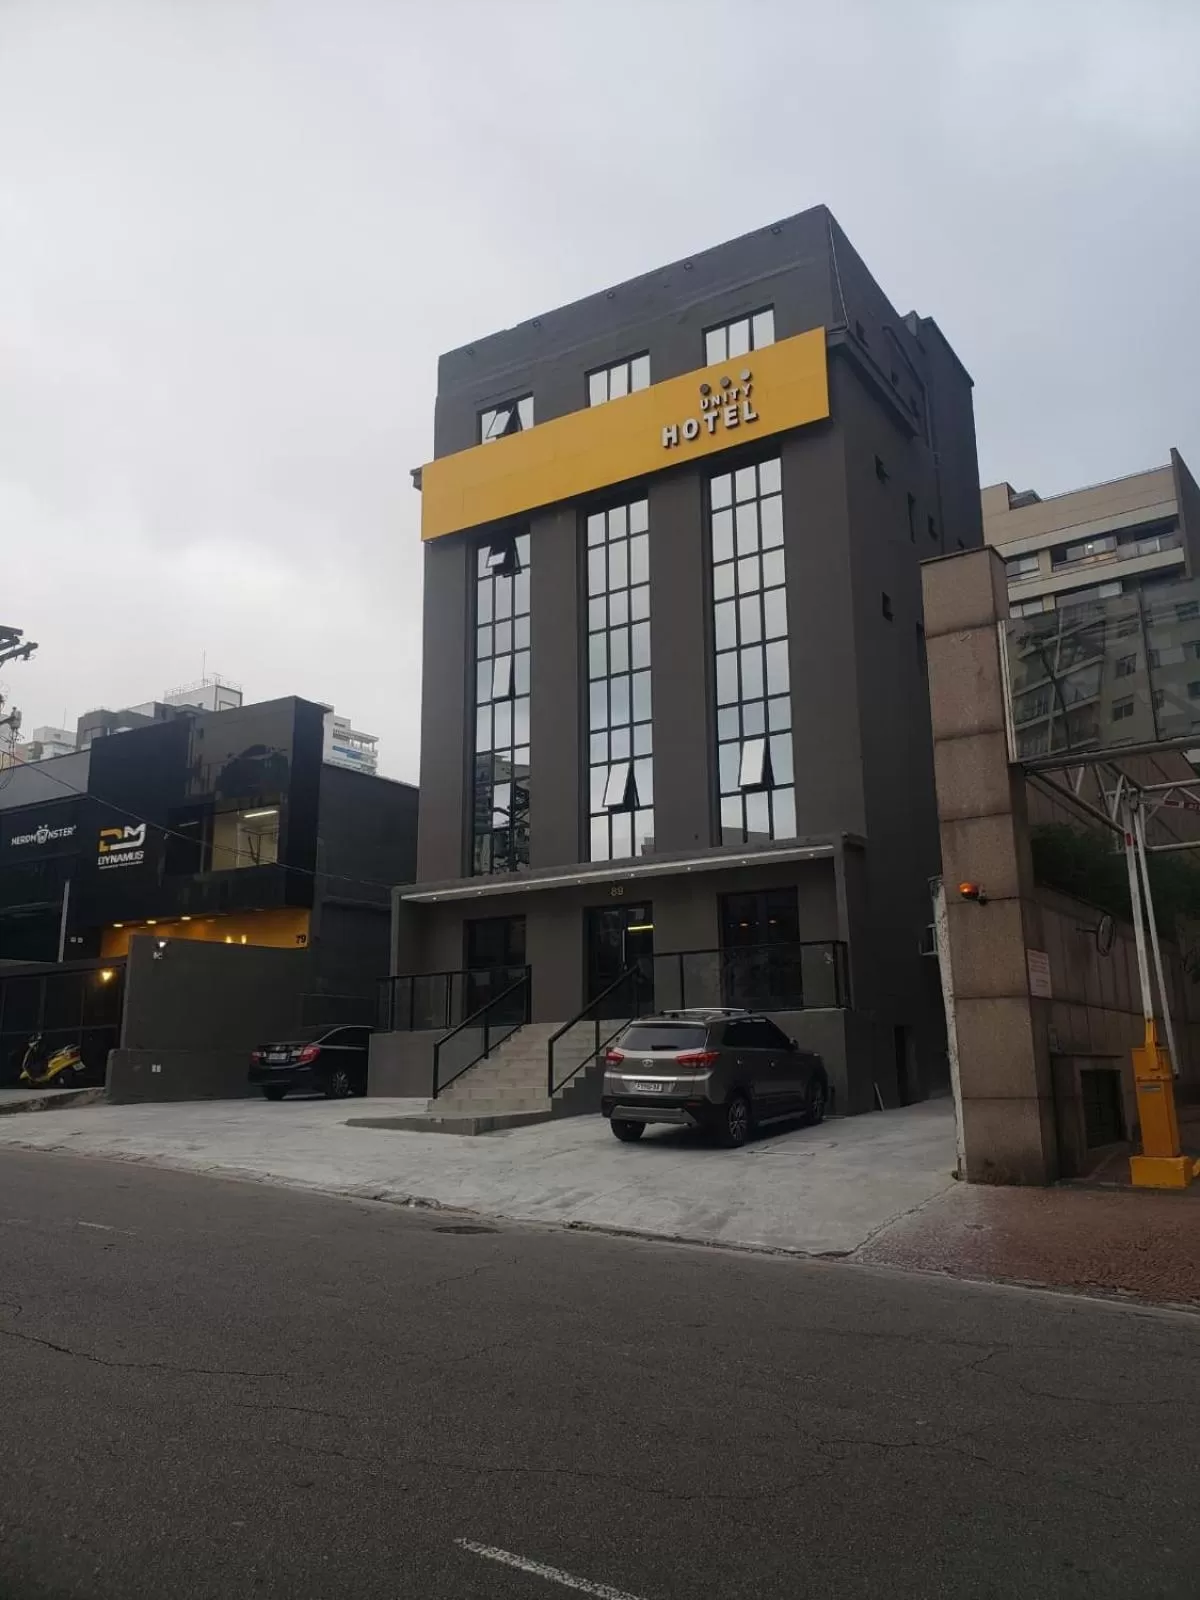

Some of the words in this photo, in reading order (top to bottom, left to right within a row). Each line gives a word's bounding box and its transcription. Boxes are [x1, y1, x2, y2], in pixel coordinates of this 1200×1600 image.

[700, 383, 753, 411] UNITY
[662, 400, 759, 448] HOTEL
[610, 886, 624, 896] 89
[295, 934, 307, 944] 79
